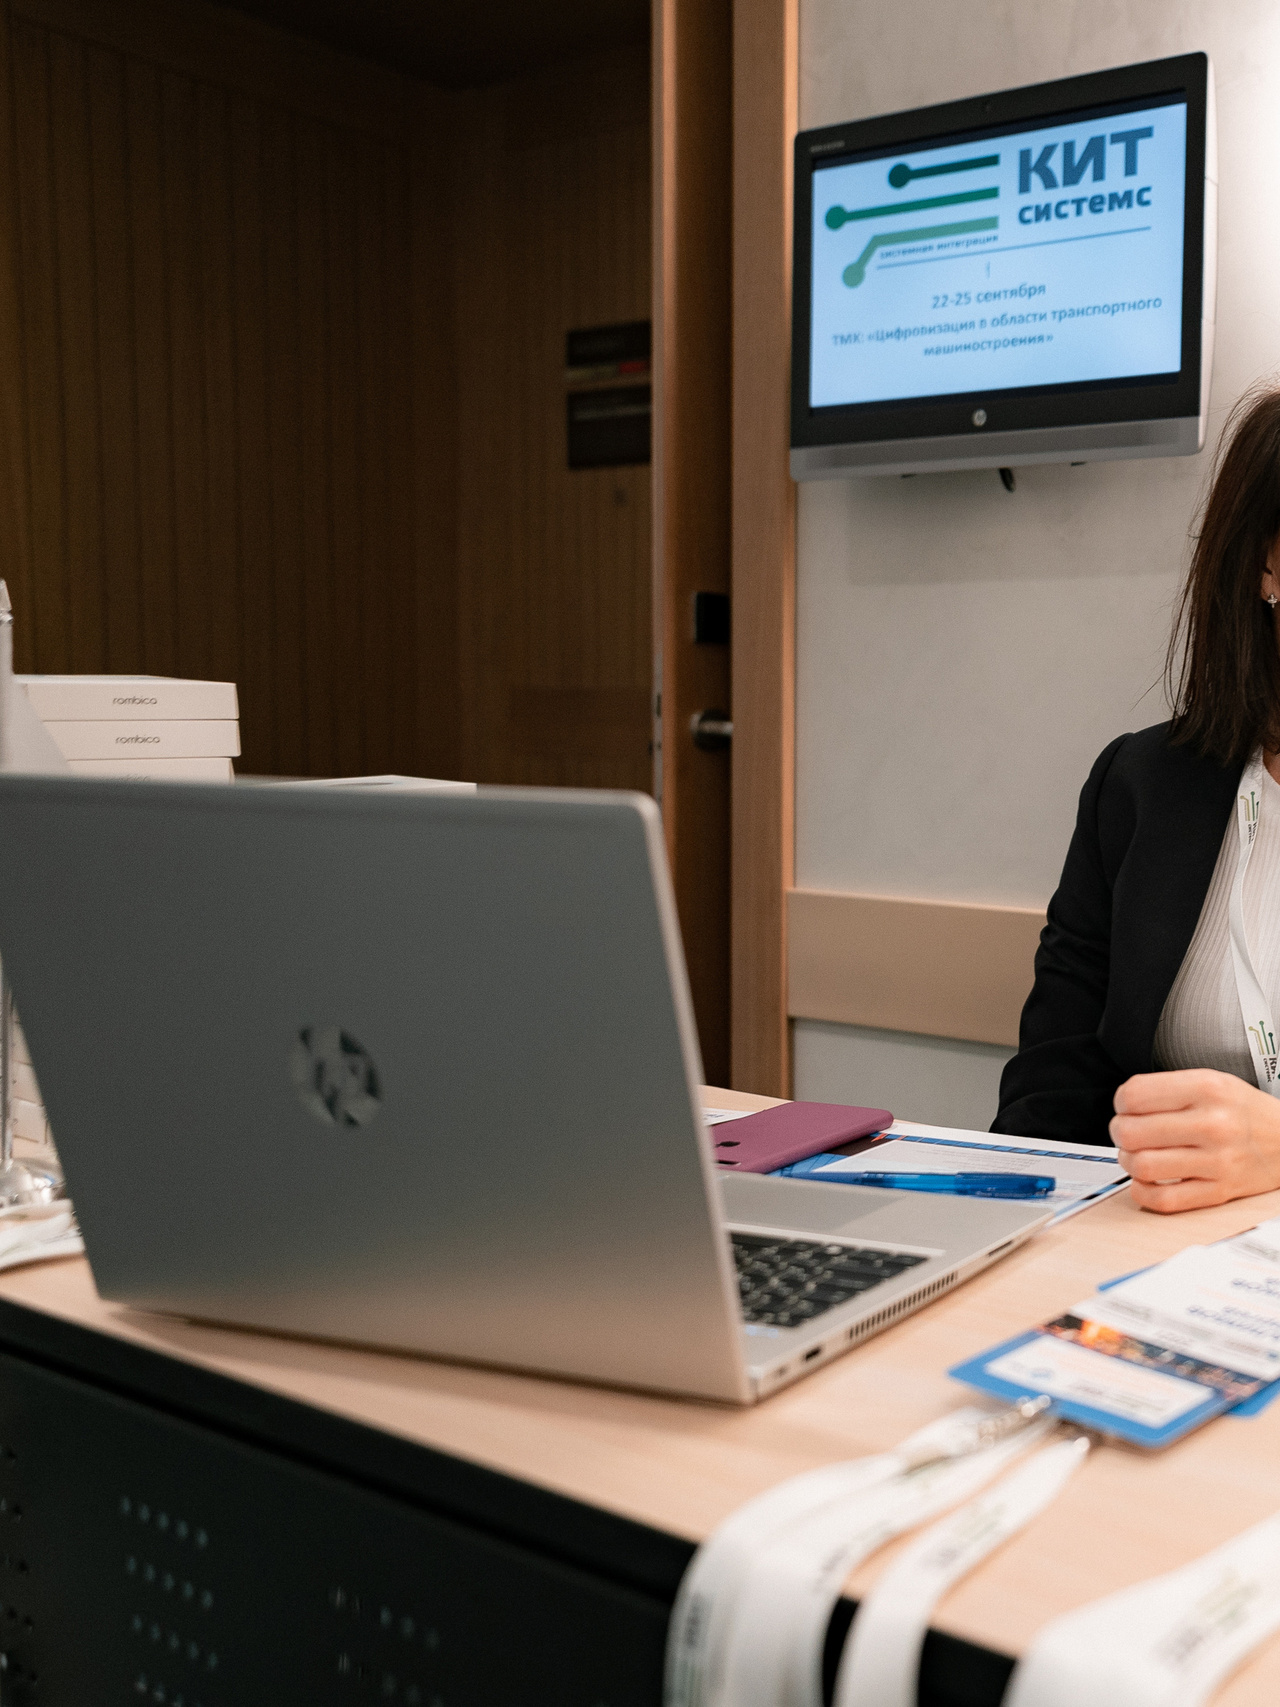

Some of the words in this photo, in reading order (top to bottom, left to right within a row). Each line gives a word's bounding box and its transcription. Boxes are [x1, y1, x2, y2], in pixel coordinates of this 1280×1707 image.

[1018, 125, 1154, 194] КИТ
[1018, 186, 1152, 225] системс
[932, 292, 972, 309] 22-25
[976, 282, 1046, 304] сентября
[980, 317, 987, 328] в
[991, 311, 1047, 328] области
[1051, 298, 1162, 322] транспортного
[924, 334, 1053, 356] машиностроения»
[112, 696, 157, 705] rombica
[115, 735, 160, 744] rombica
